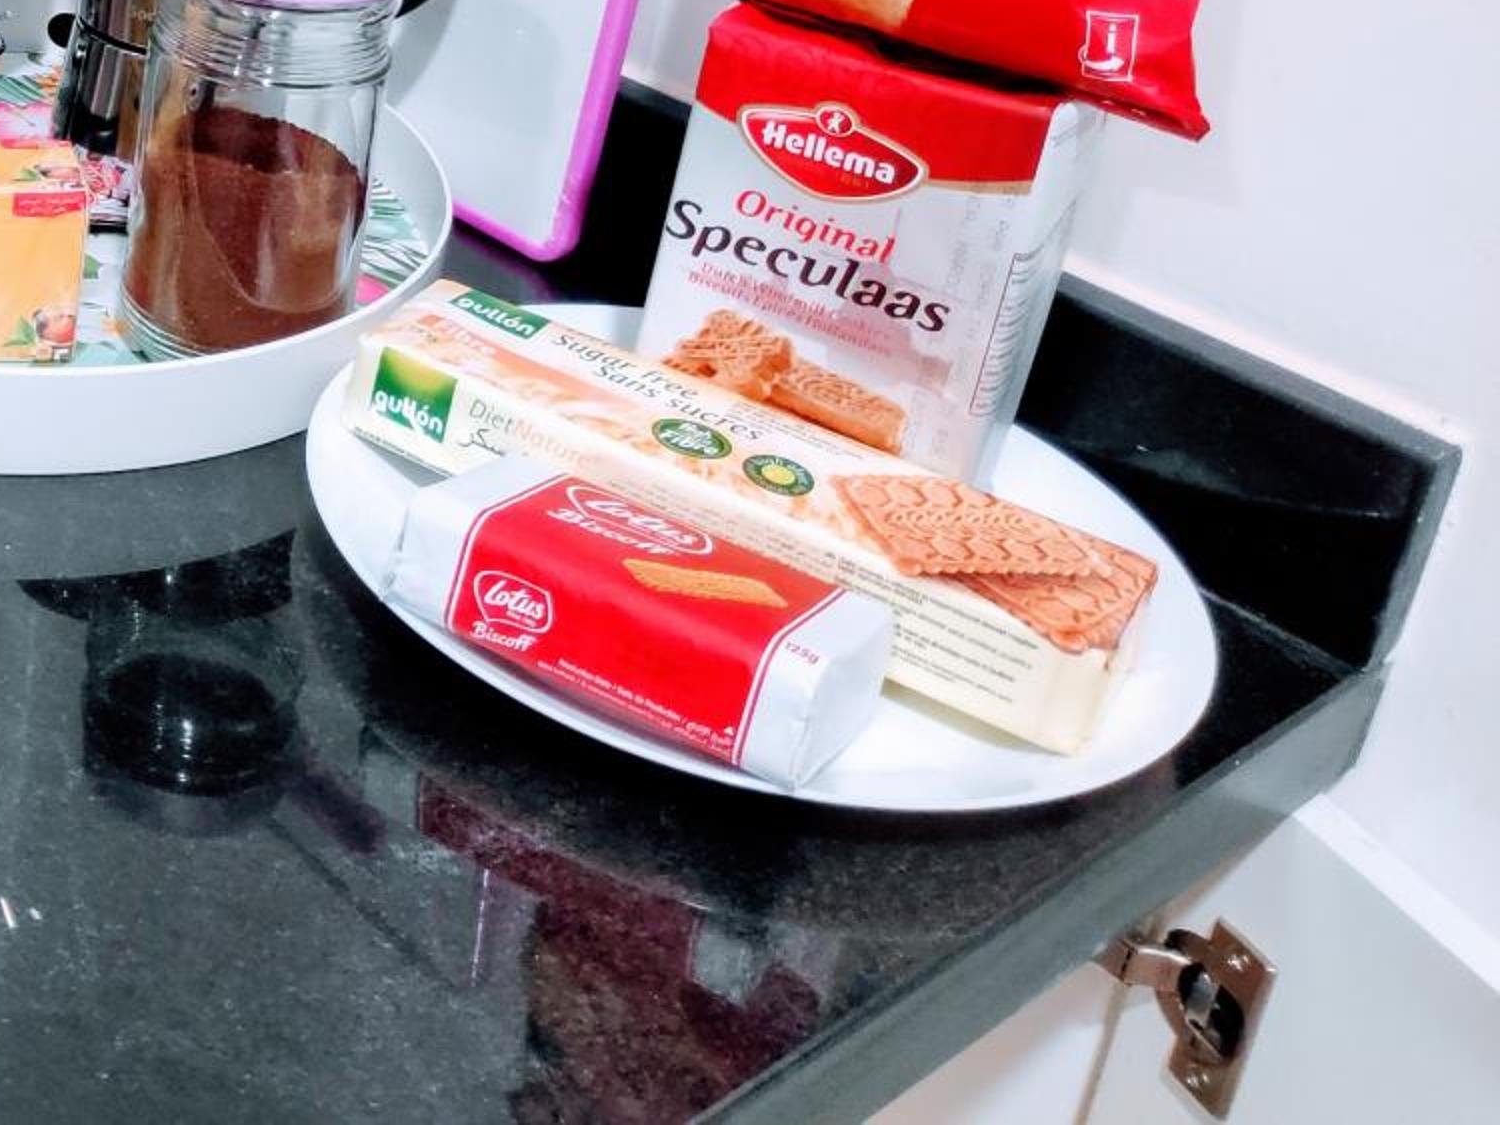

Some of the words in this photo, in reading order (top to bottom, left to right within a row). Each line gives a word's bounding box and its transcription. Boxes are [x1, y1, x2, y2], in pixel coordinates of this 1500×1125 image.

[762, 120, 896, 185] Hellema
[735, 189, 896, 264] Original
[665, 199, 950, 332] Speculaas
[457, 296, 536, 336] gullón
[551, 333, 638, 371] Sugar
[642, 369, 699, 401] free
[373, 389, 445, 439] gullón
[593, 366, 663, 399] Sans
[664, 398, 768, 442] sucres
[484, 579, 546, 620] Lotus
[471, 620, 539, 652] Biscoff
